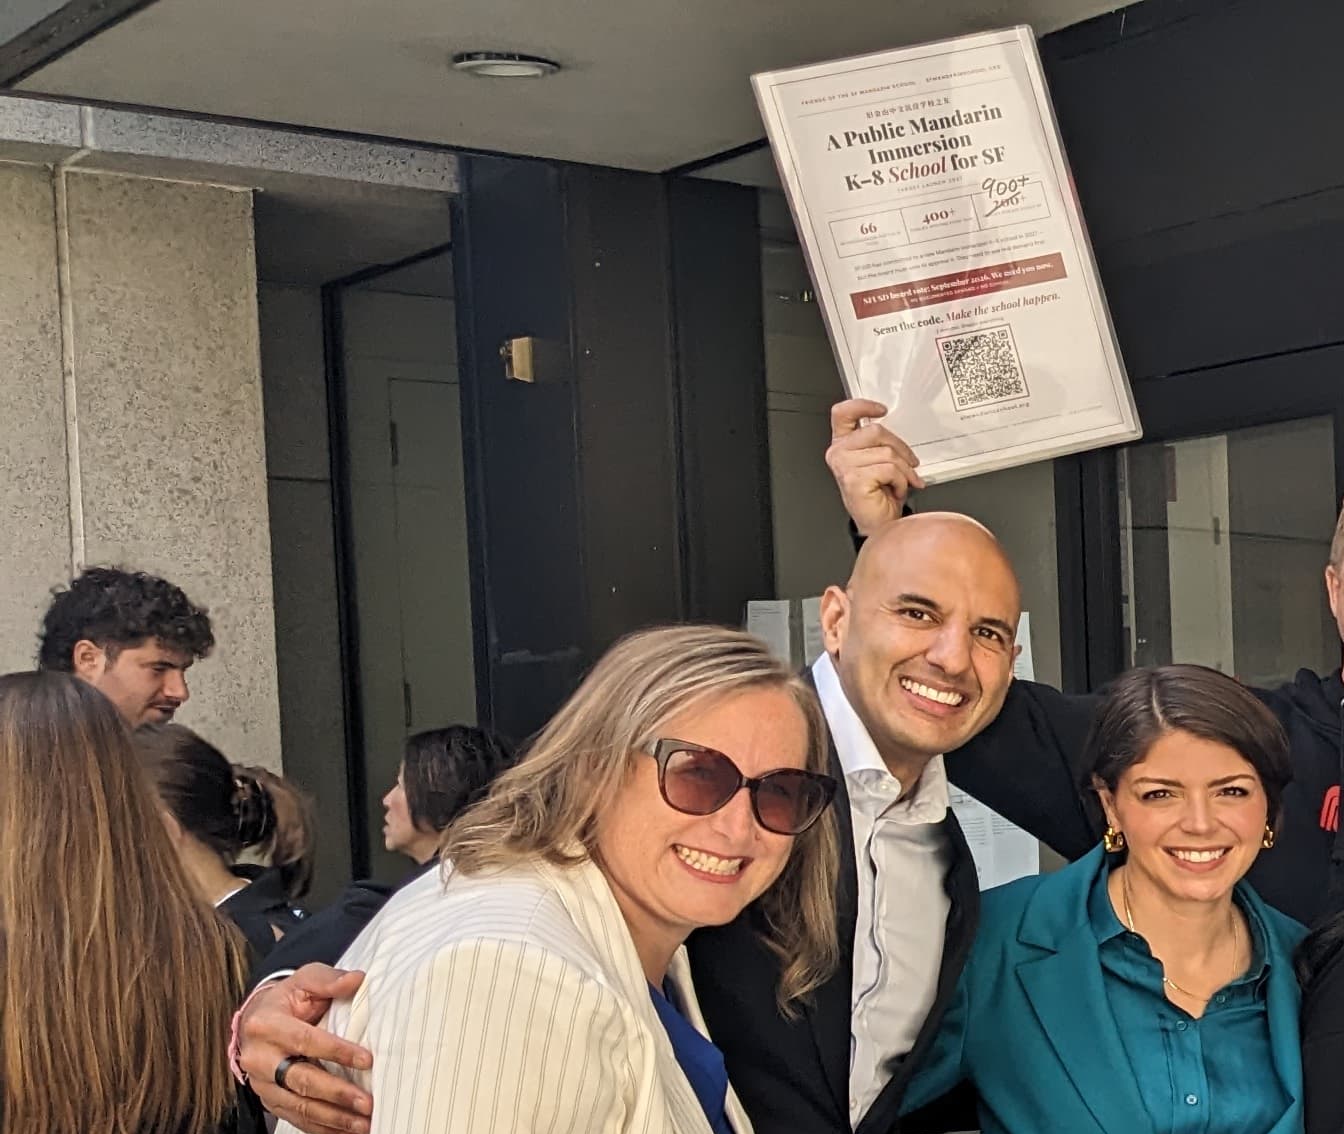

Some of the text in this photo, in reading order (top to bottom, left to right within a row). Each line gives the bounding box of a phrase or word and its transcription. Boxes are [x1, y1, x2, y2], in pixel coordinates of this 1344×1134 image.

[827, 104, 1003, 151] A Public Mandarin
[868, 133, 972, 166] Immersion
[888, 155, 947, 184] School
[949, 153, 979, 172] for
[982, 146, 1006, 165] SF
[982, 175, 1030, 198] 900+
[860, 222, 877, 236] 66
[922, 208, 956, 226] 400+
[931, 278, 970, 294] September
[873, 323, 898, 337] Scan
[899, 318, 916, 331] the
[917, 314, 944, 329] code.
[946, 308, 972, 322] Make
[974, 305, 989, 317] the
[991, 299, 1021, 315] school
[1023, 291, 1061, 309] happen.
